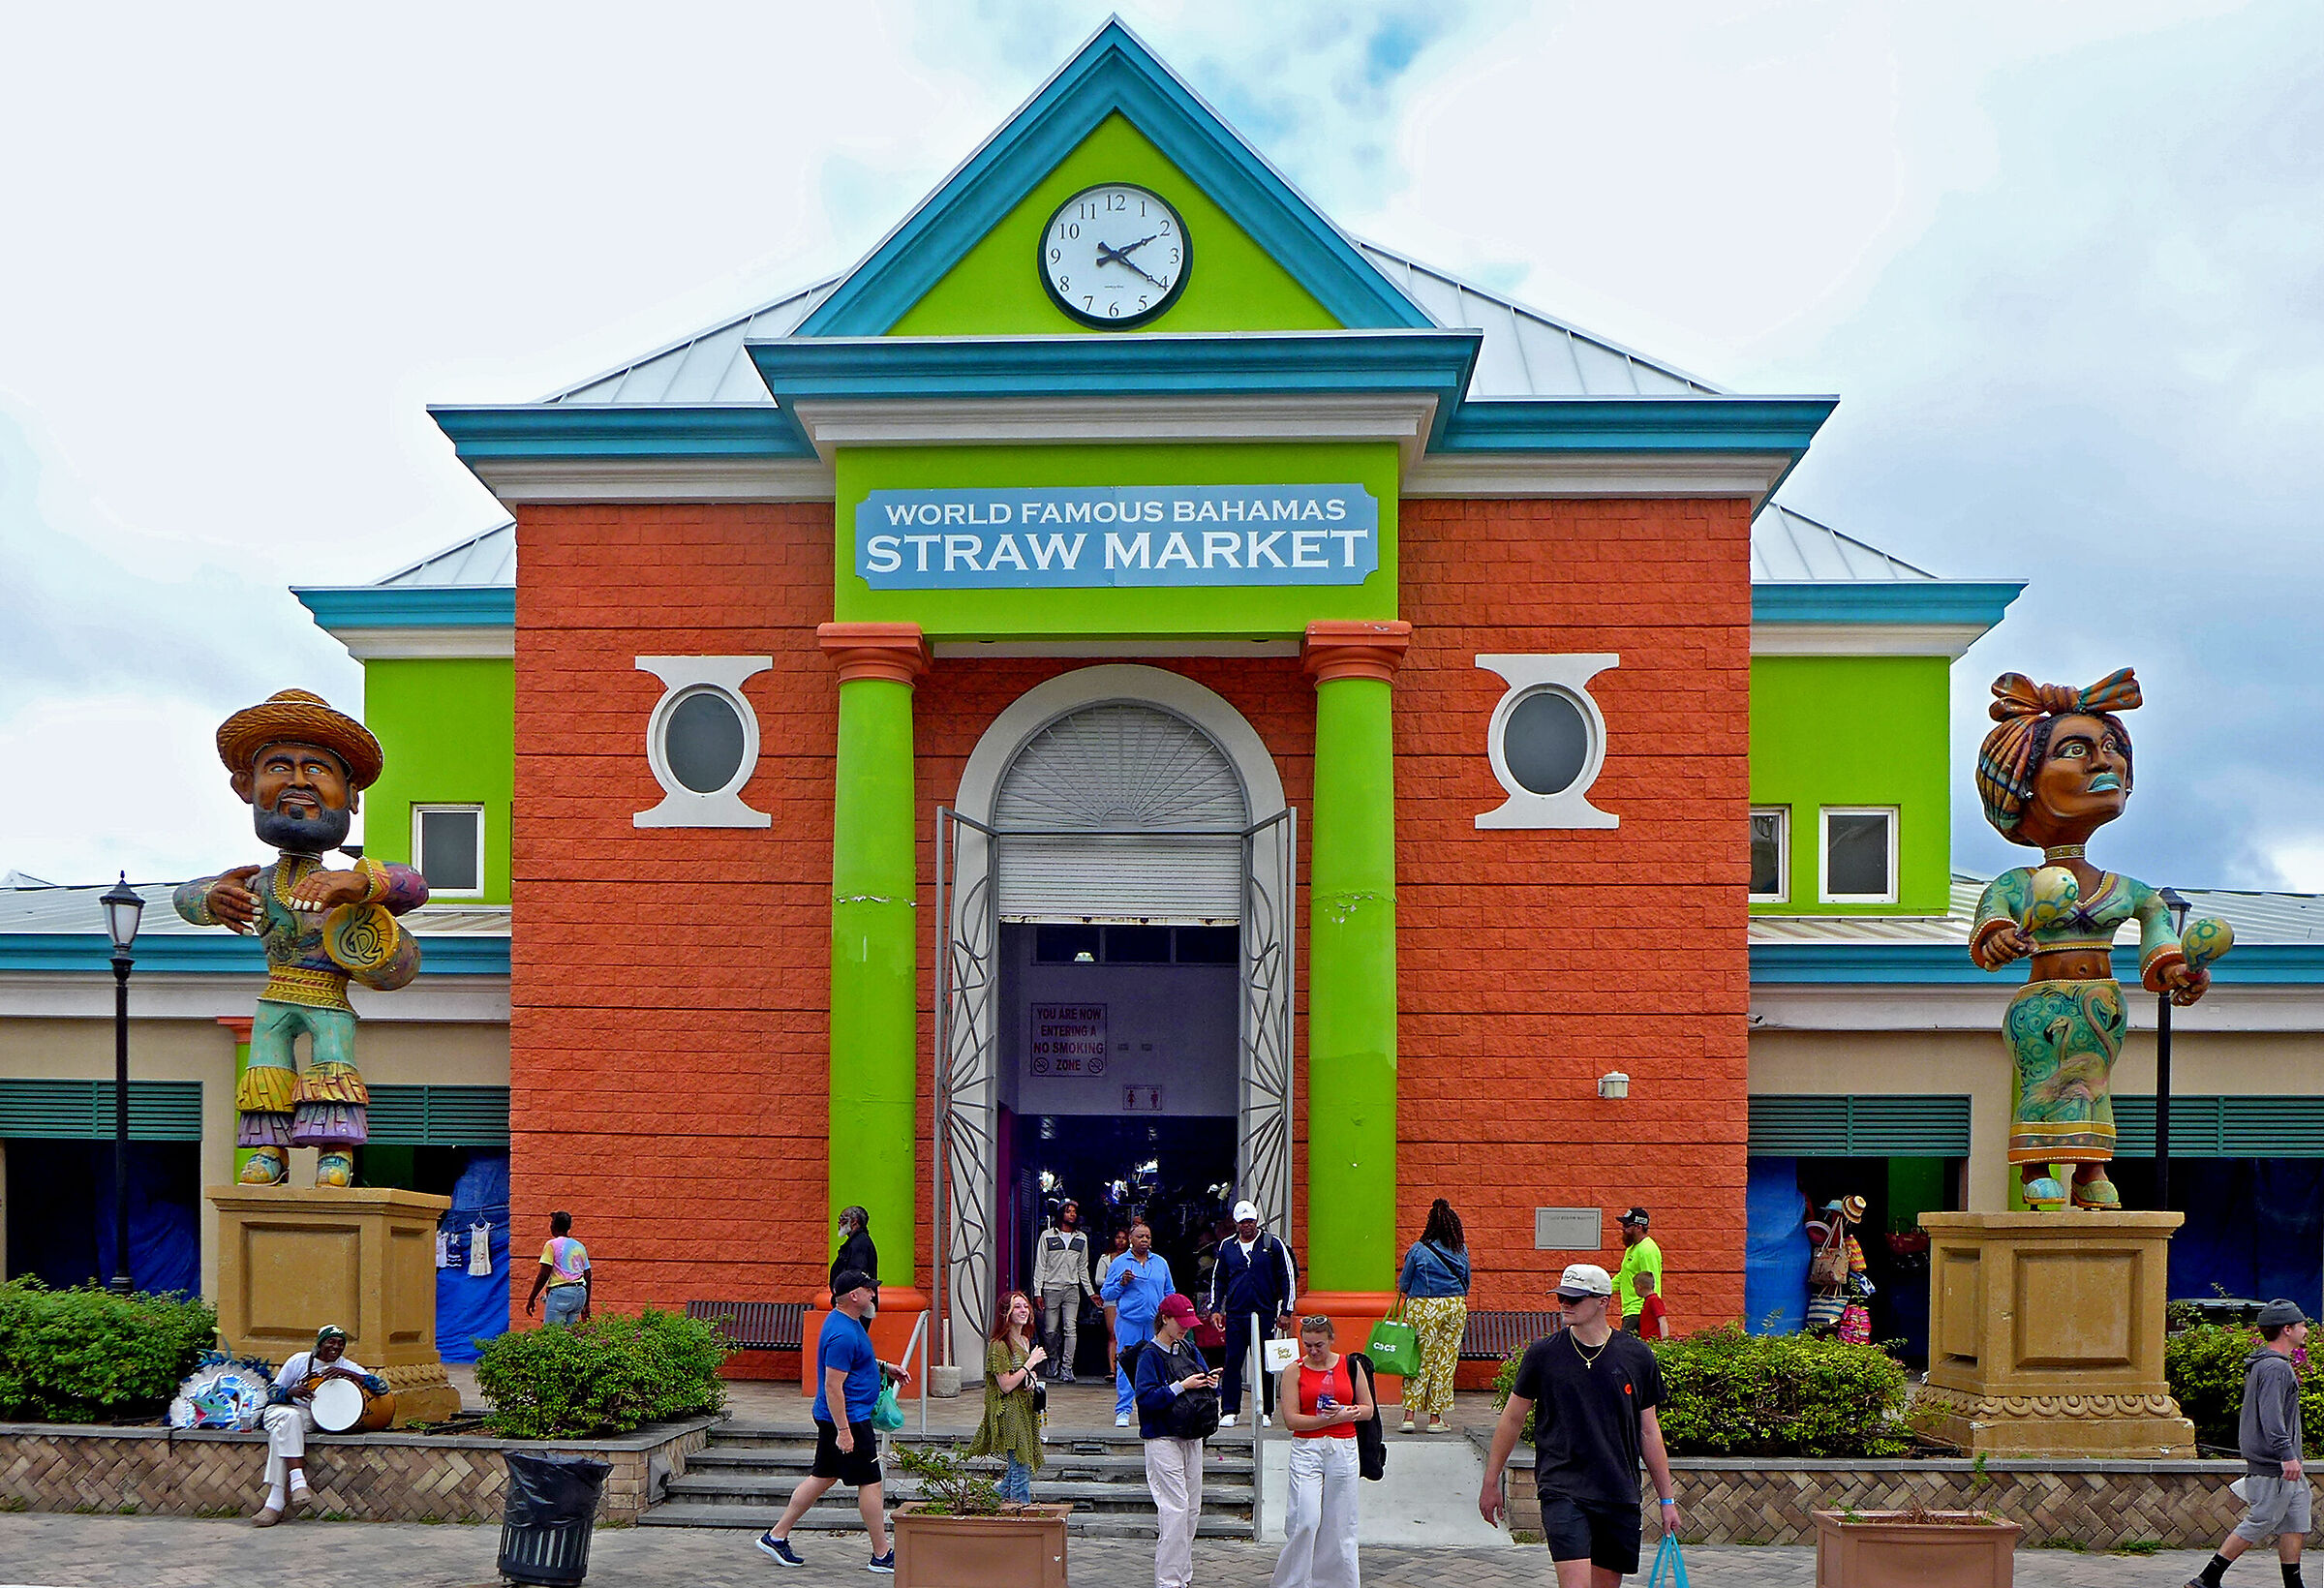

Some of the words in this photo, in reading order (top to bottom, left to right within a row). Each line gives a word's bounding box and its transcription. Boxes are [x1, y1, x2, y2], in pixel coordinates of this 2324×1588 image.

[1106, 194, 1126, 211] 12
[1140, 200, 1146, 217] 1
[1080, 203, 1096, 220] 11
[1059, 223, 1080, 239] 10
[1159, 220, 1171, 236] 2
[1050, 248, 1061, 264] 9
[1170, 248, 1179, 264] 3
[1059, 276, 1070, 291] 8
[1159, 275, 1170, 291] 4
[1083, 295, 1094, 311] 7
[1108, 301, 1119, 317] 6
[1138, 295, 1147, 312] 5
[884, 503, 1012, 526] WORLD
[1021, 501, 1164, 524] FAMOUS
[1173, 499, 1346, 522] BAHAMAS
[866, 533, 1088, 572] STRAW
[1103, 529, 1368, 569] MARKET
[1037, 1008, 1055, 1020] YOU
[1058, 1008, 1078, 1020] ARE
[1080, 1008, 1102, 1020] NOW
[1040, 1024, 1087, 1037] ENTERING
[1090, 1025, 1096, 1037] A
[1033, 1042, 1050, 1054] NO
[1052, 1042, 1104, 1054] SMOKING
[1055, 1059, 1082, 1071] ZONE
